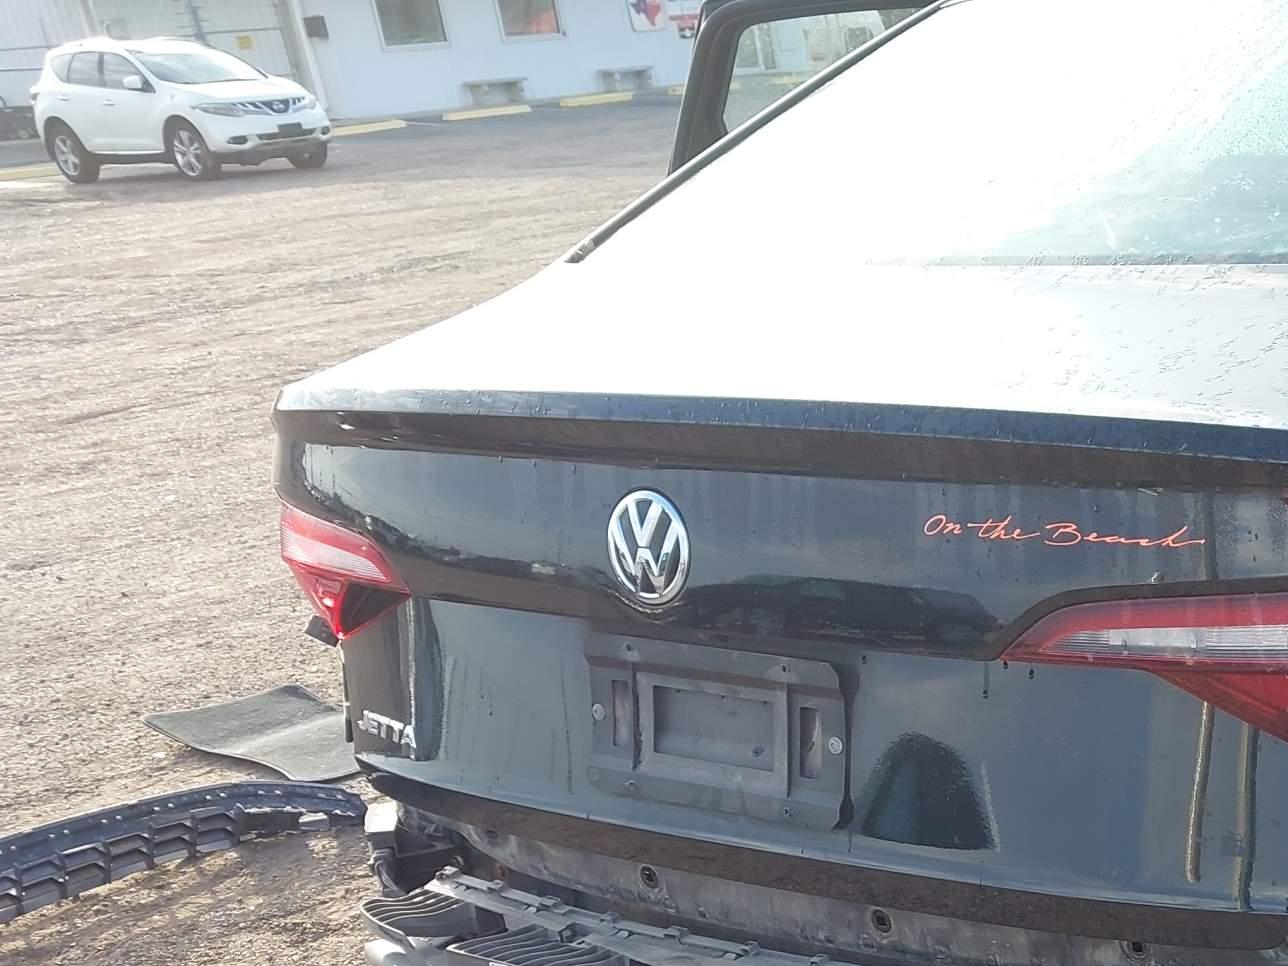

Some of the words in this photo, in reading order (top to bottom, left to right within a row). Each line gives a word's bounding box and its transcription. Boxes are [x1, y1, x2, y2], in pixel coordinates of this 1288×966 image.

[608, 490, 689, 605] VW
[923, 514, 963, 536] On
[967, 515, 1041, 540] the
[1044, 522, 1206, 548] Beach
[356, 709, 417, 749] JETTA
